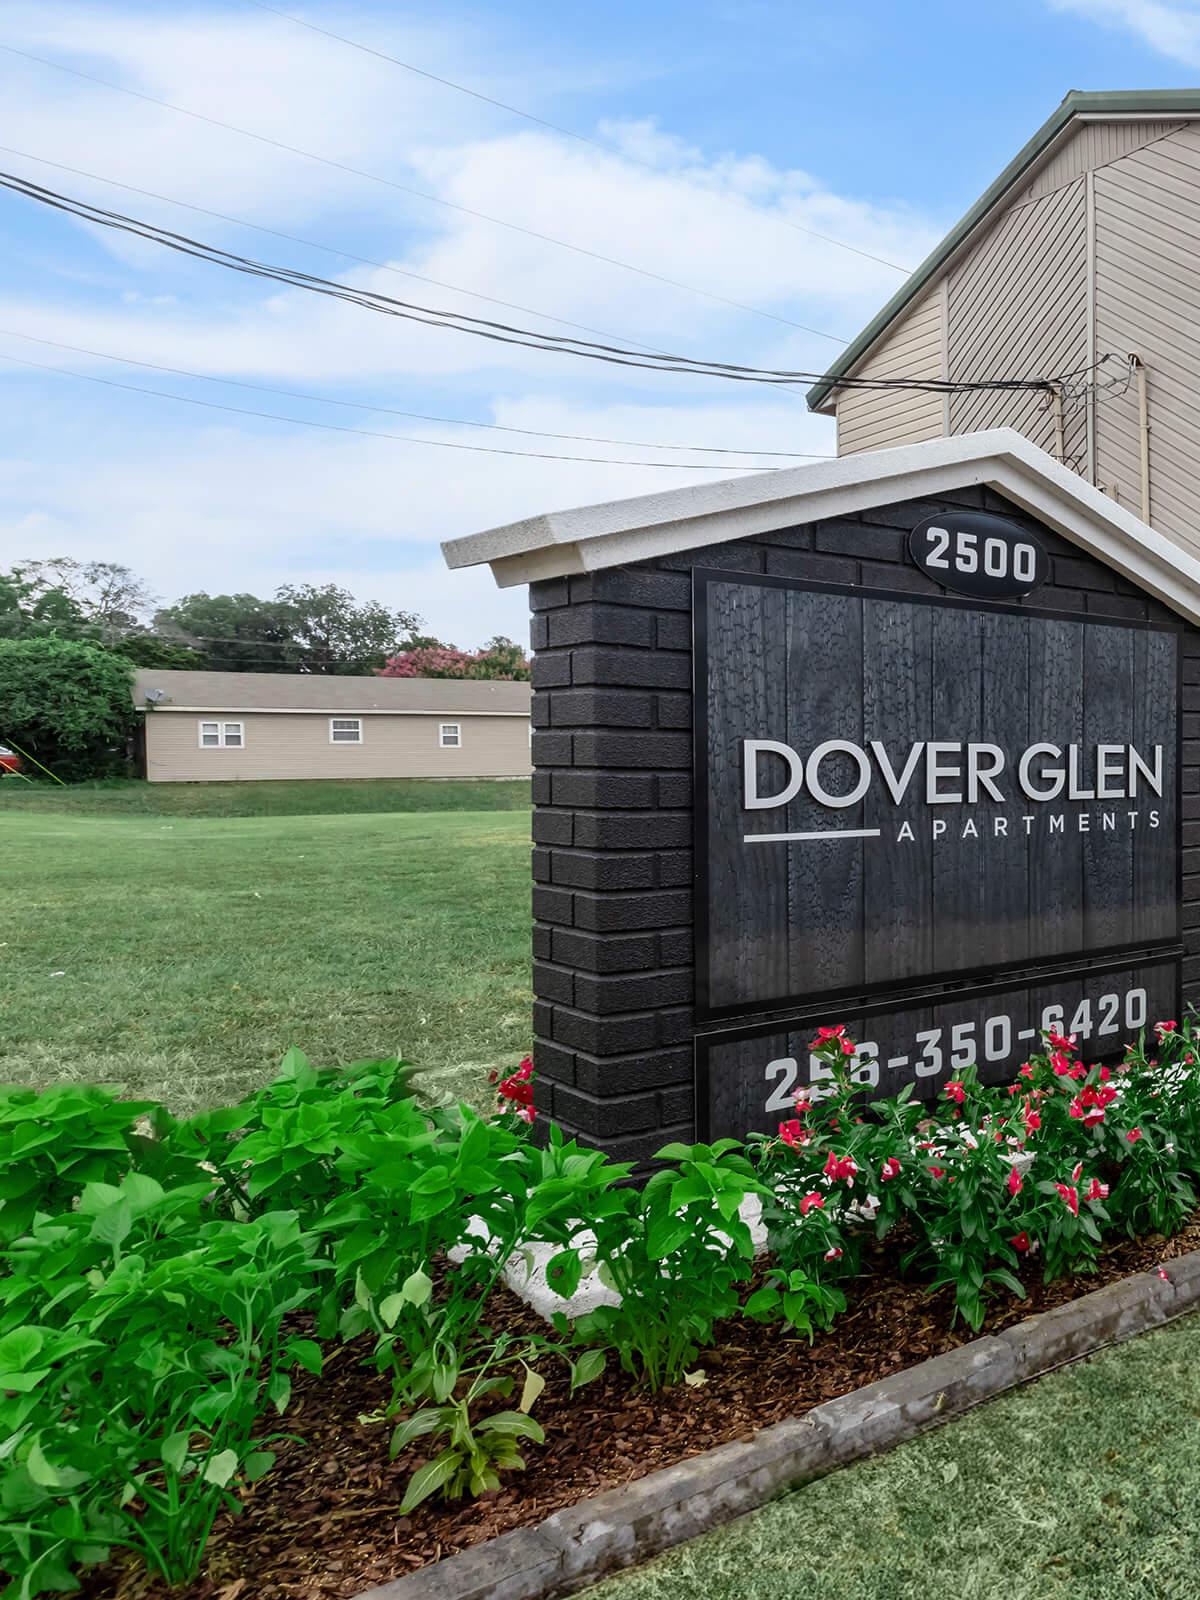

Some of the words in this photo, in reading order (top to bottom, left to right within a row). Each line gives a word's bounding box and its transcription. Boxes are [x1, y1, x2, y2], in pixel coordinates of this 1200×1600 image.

[925, 526, 1036, 582] 2500
[743, 739, 1006, 810] DOVER
[1018, 742, 1163, 801] GLEN
[896, 810, 1161, 842] APARTMENTS
